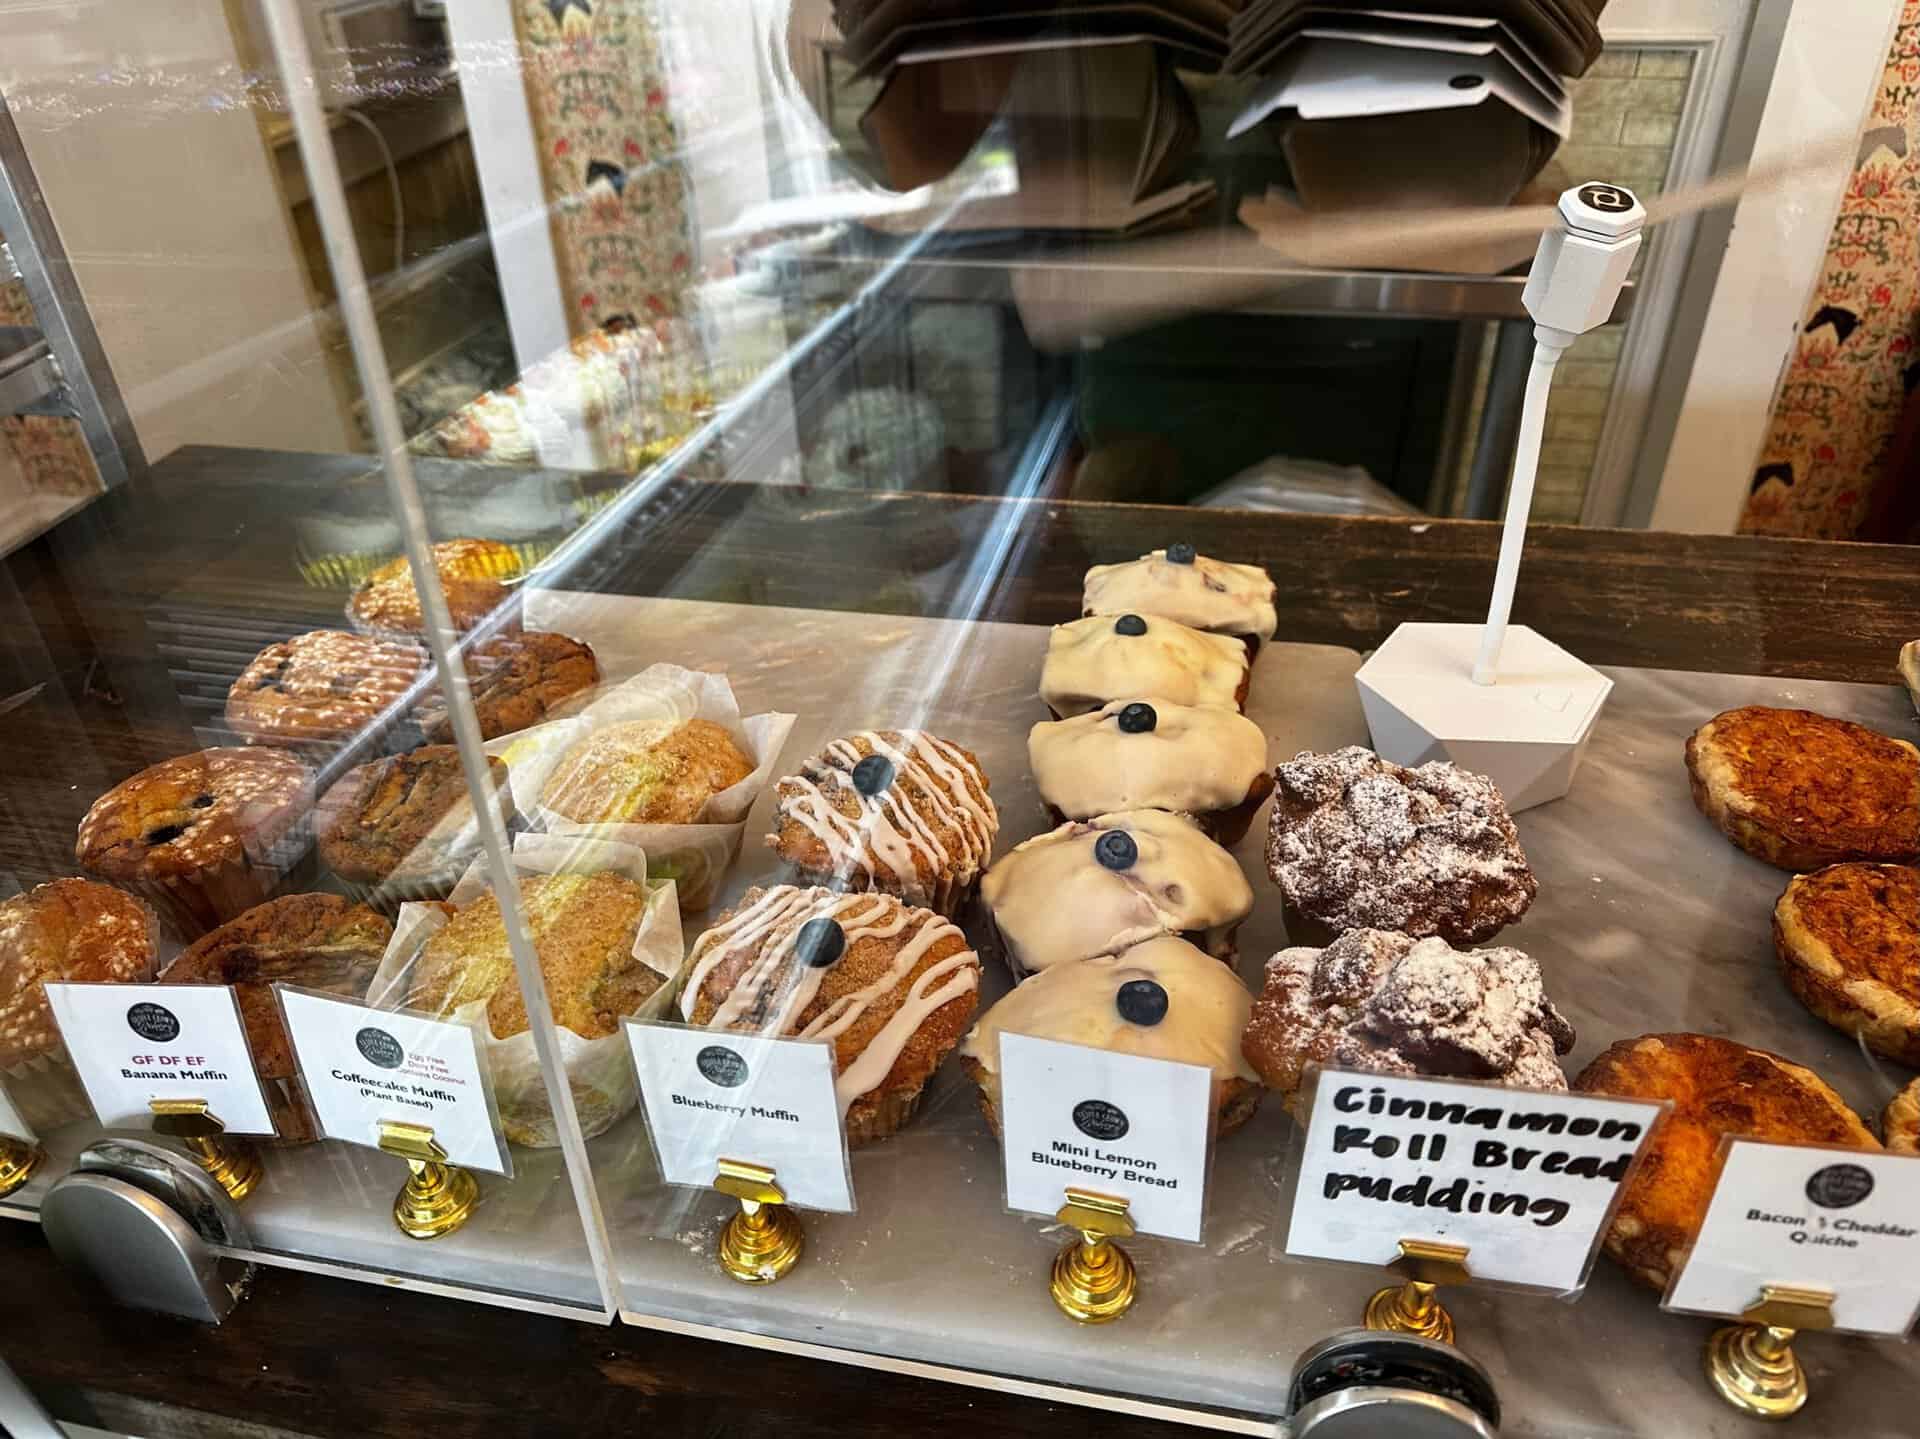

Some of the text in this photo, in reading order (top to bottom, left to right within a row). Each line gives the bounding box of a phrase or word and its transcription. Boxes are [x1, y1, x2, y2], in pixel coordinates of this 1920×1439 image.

[120, 1068, 228, 1081] Banana Muffin
[132, 1055, 206, 1066] GF DF EF
[331, 1069, 408, 1093] Coffeecake
[411, 1085, 456, 1103] Muffin
[360, 1089, 434, 1111] (Plant Based)
[672, 1094, 800, 1123] Blueberry Muffin
[1333, 1086, 1642, 1142] Cinnamon
[1052, 1140, 1157, 1171] Mini Lemon
[1332, 1125, 1633, 1182] Roll Bread
[1031, 1151, 1178, 1189] Blueberry Bread
[1746, 1208, 1806, 1226] Bacon
[1833, 1218, 1918, 1238] Cheddar
